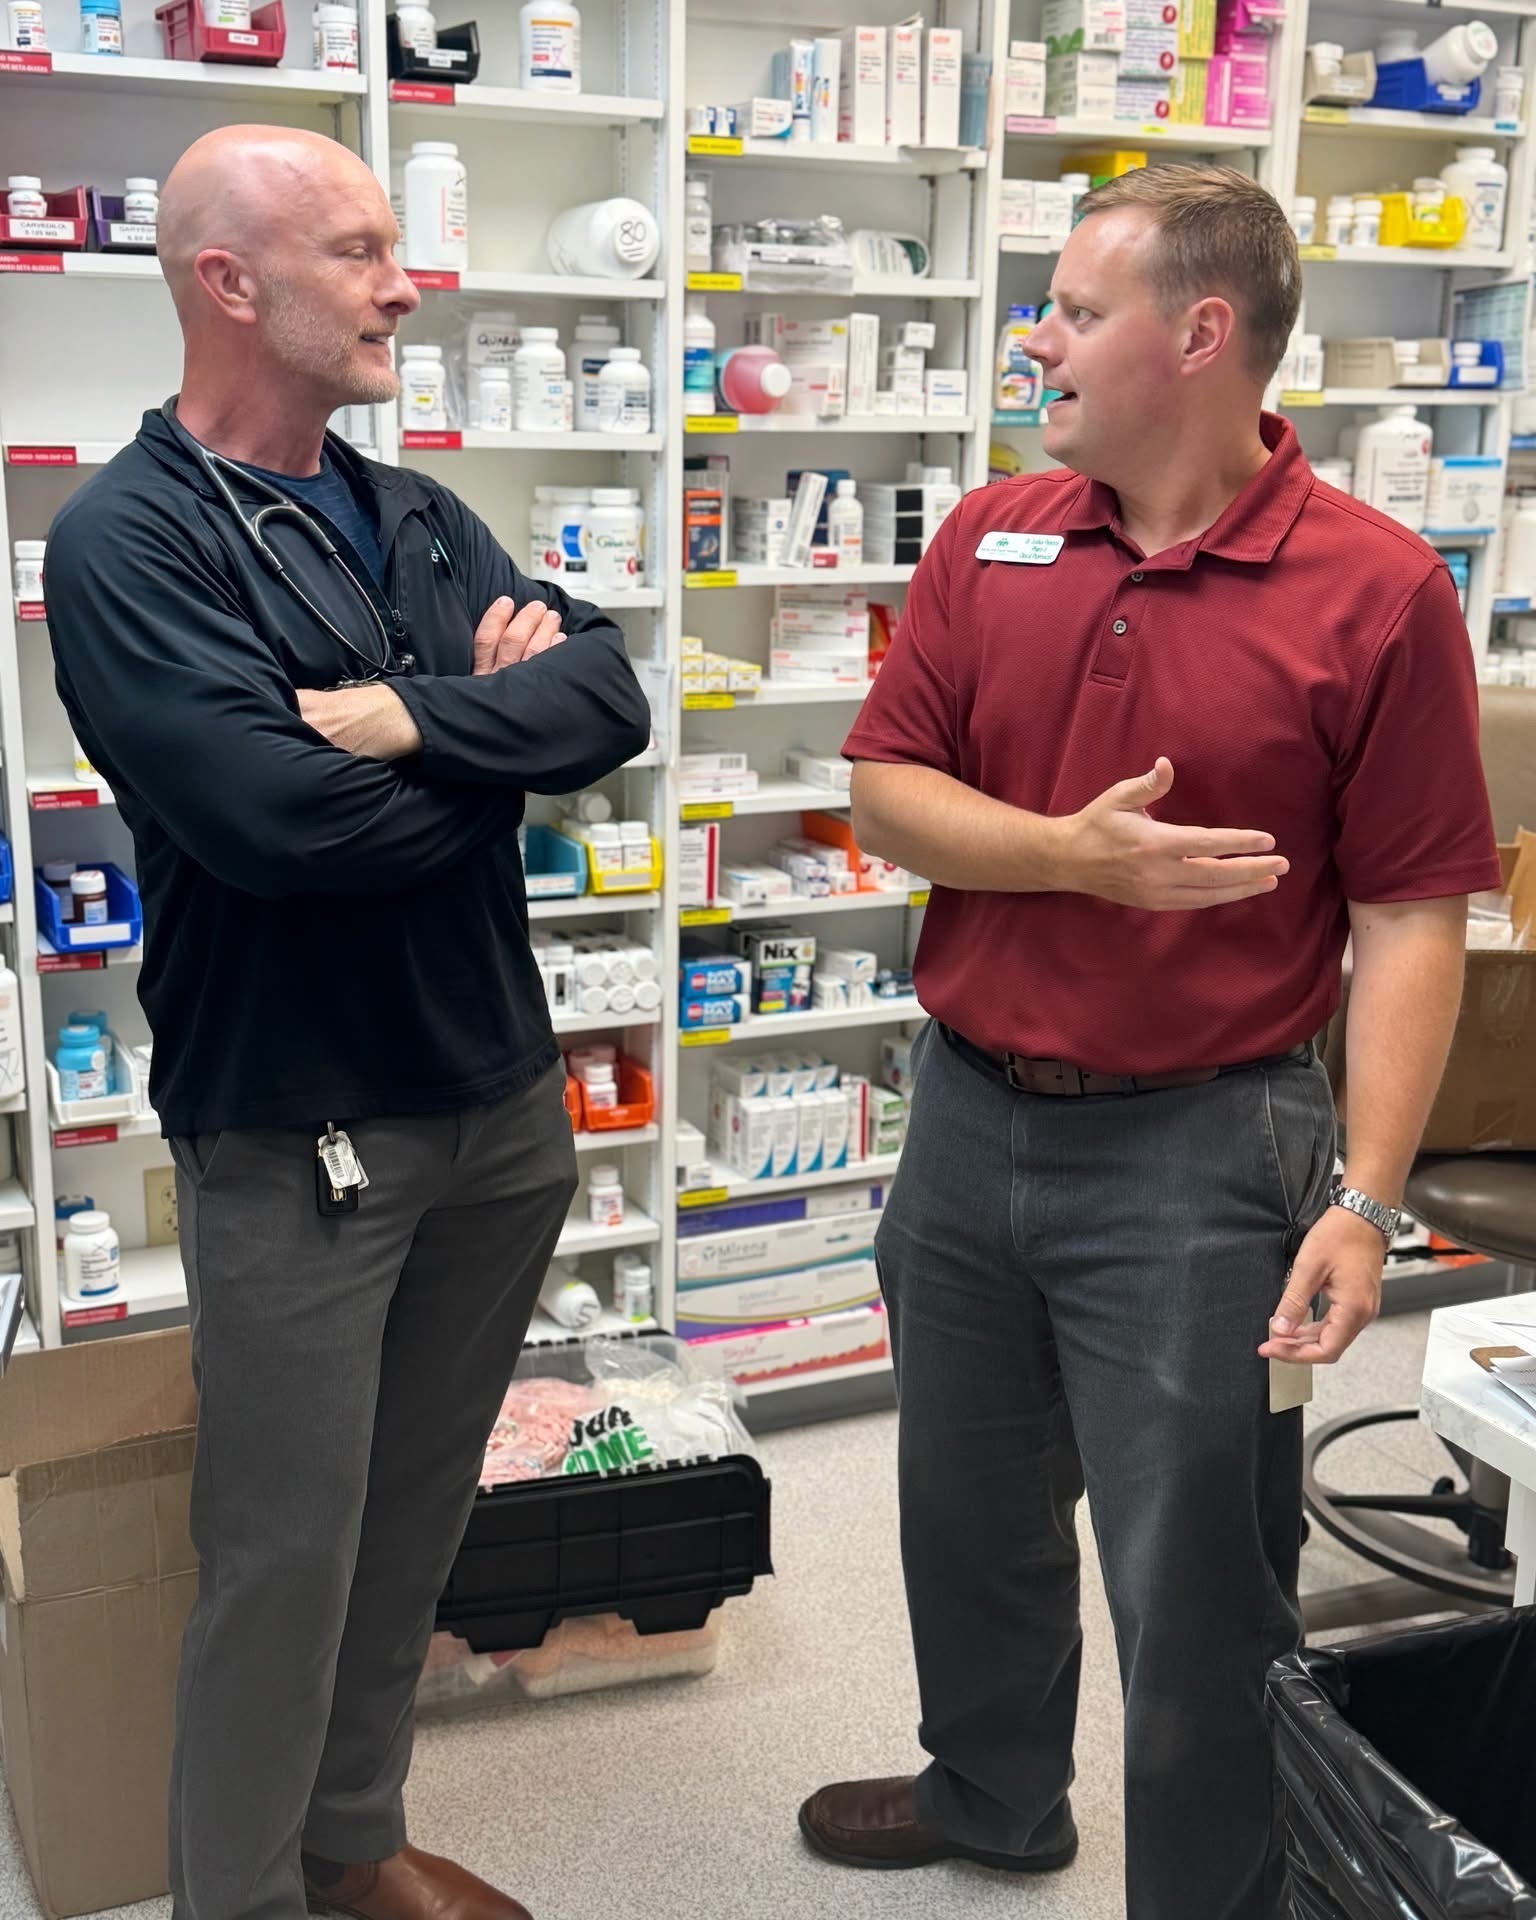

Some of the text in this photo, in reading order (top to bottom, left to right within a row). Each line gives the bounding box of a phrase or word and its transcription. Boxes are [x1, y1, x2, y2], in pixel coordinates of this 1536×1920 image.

[619, 220, 647, 246] 80
[764, 943, 798, 960] Nix
[717, 1241, 768, 1257] Mirena
